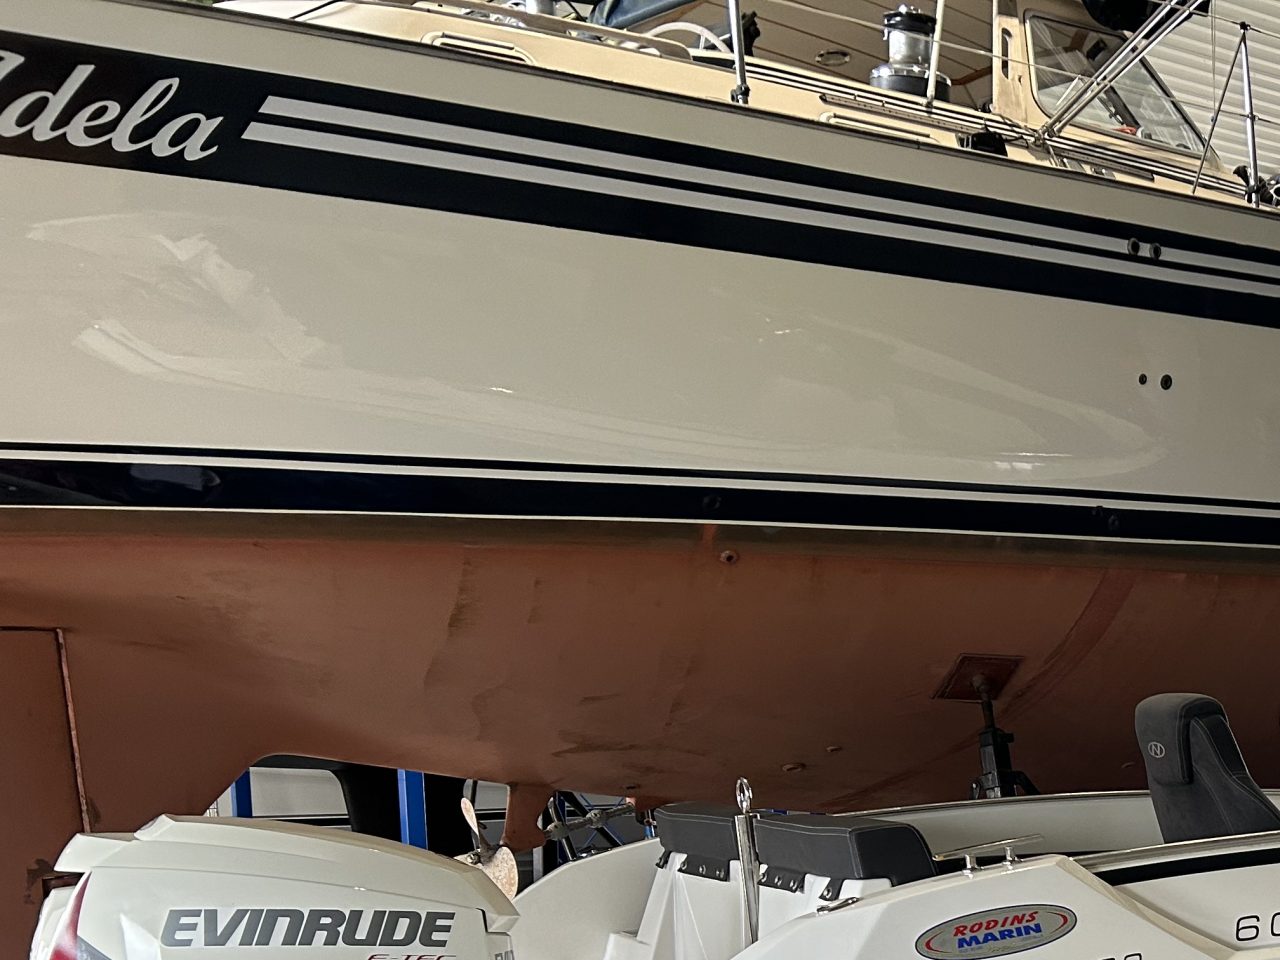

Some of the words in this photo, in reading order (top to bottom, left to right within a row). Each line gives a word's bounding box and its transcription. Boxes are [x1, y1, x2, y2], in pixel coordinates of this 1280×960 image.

[160, 908, 456, 948] EVINRUDE
[953, 911, 1039, 937] RODINS
[957, 922, 1042, 949] MARIN
